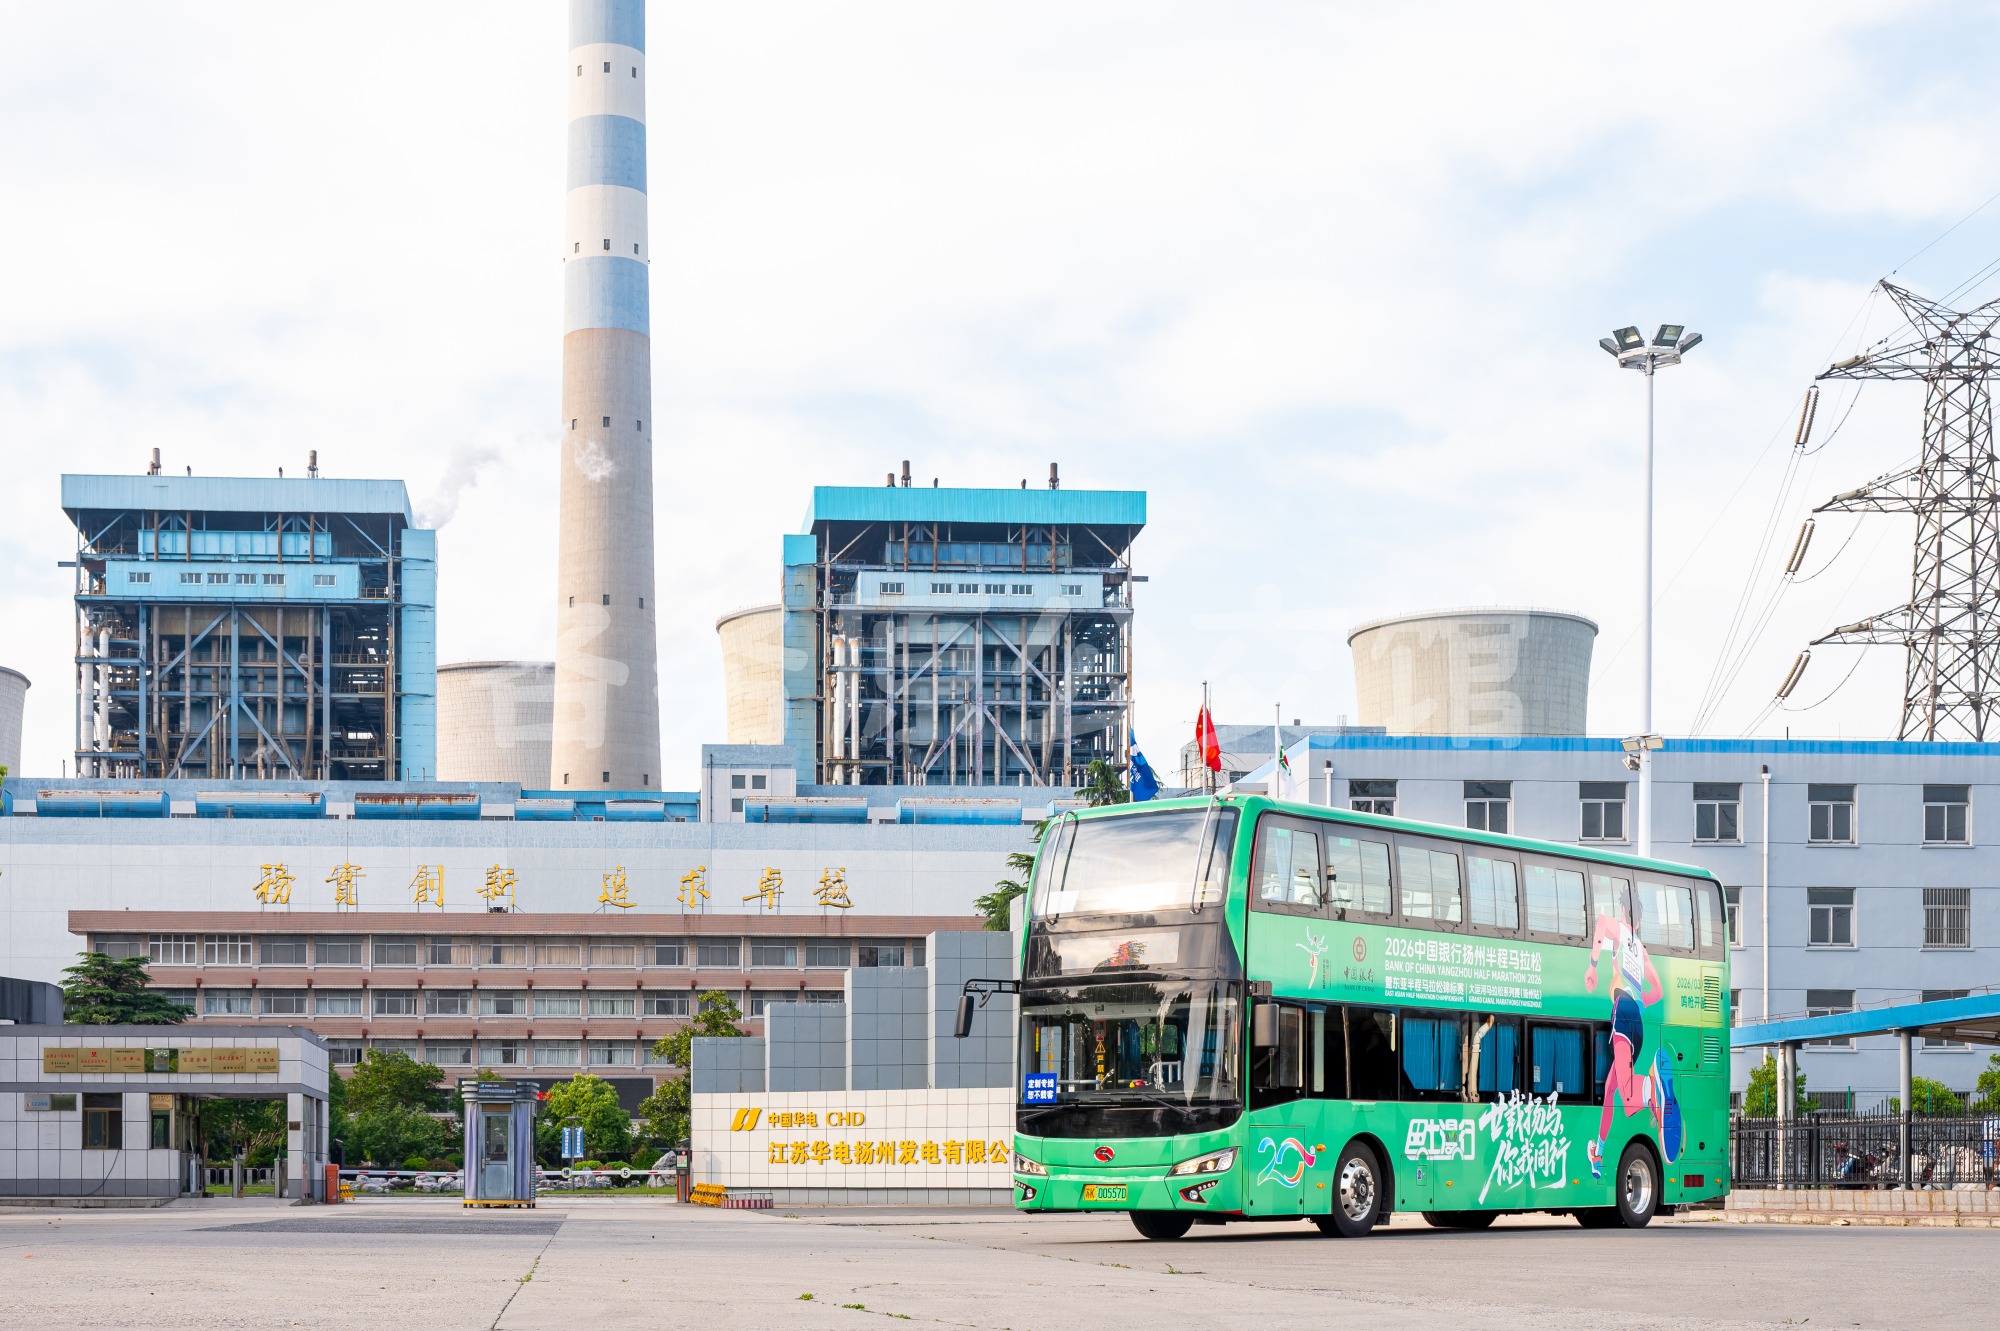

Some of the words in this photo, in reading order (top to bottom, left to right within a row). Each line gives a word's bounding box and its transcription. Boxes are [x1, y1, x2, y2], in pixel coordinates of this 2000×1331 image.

[597, 865, 854, 909] 追求卓越
[1385, 938, 1542, 972] 2026中国银行扬州半程马拉松
[1344, 965, 1375, 983] 中国银行
[1385, 960, 1404, 973] BANK
[1405, 962, 1415, 973] OF
[1415, 963, 1436, 975] CHINA
[1437, 965, 1473, 978] YANGZHOU
[1473, 968, 1490, 980] HALF
[1491, 970, 1526, 983] MARATHON
[1527, 974, 1542, 985] 2026
[1385, 976, 1465, 996] 暨东亚半程马拉松锦标赛
[1415, 992, 1435, 1001] MARATHON
[1027, 1078, 1054, 1088] 定制专线
[768, 1111, 818, 1128] 中国华电
[826, 1111, 865, 1127] CHD
[768, 1139, 1014, 1166] 江苏华电扬州发电有限公
[1478, 1137, 1572, 1205] 你我同行
[1085, 1188, 1095, 1199] 苏K
